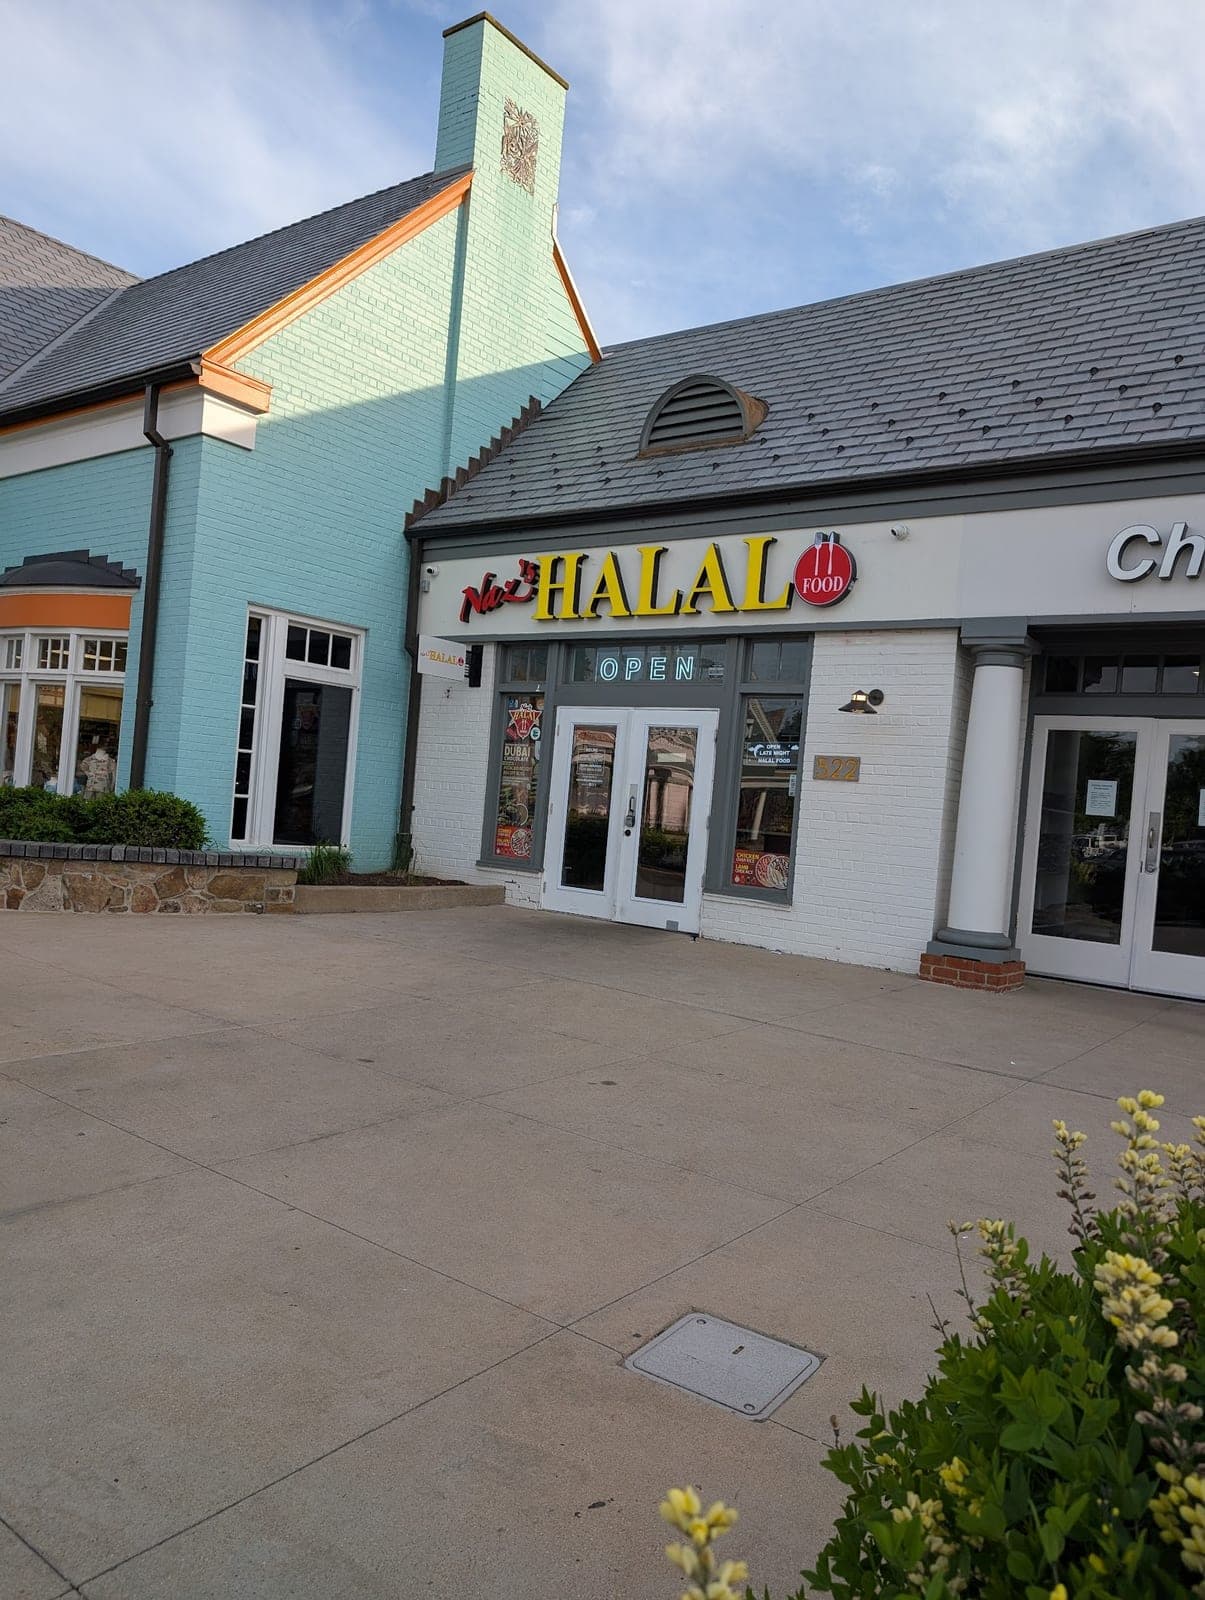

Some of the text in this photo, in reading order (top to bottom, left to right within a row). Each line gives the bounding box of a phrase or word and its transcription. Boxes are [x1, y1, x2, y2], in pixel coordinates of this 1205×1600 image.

[531, 536, 795, 620] HALAL
[802, 576, 843, 593] FOOD
[600, 656, 694, 681] OPEN
[504, 745, 531, 757] DUBAI
[815, 757, 858, 780] 522
